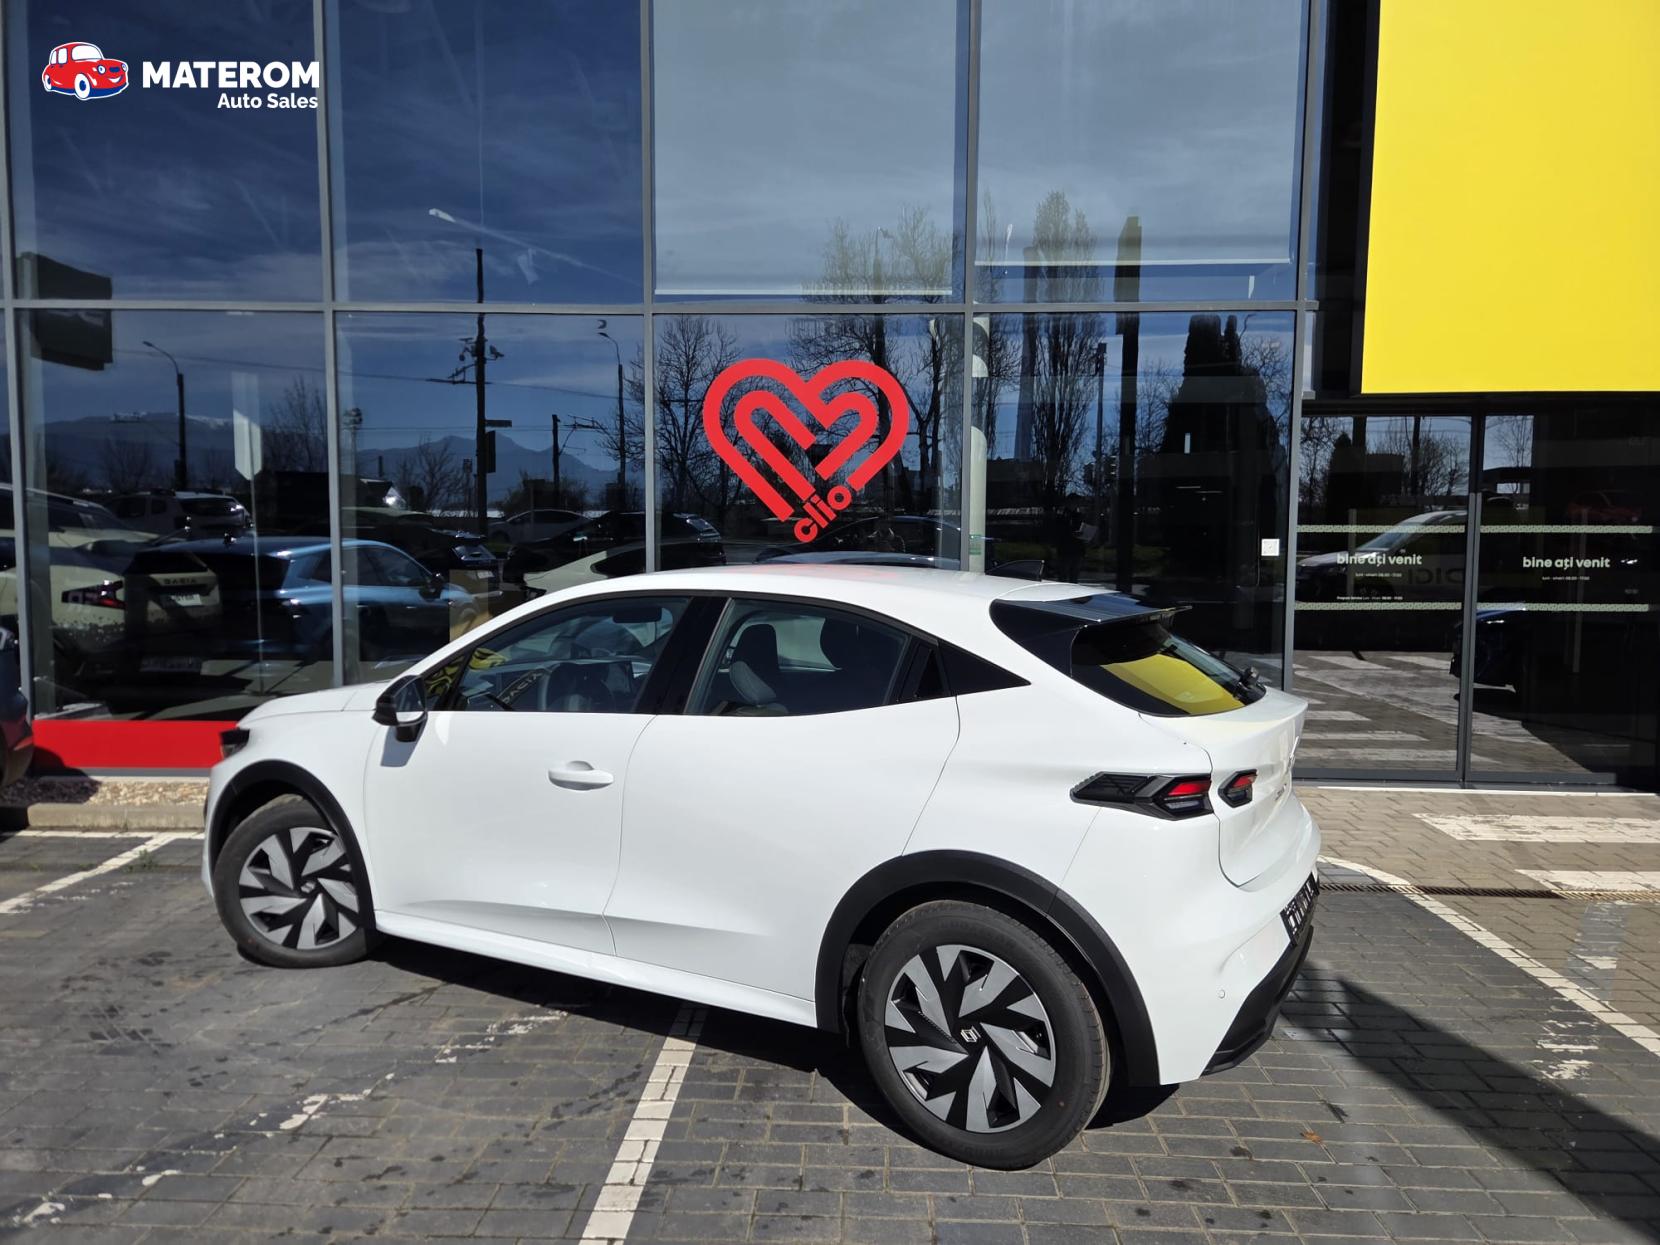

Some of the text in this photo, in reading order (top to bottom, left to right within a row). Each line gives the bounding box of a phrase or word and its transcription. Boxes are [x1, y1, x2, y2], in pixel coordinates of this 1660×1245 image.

[794, 485, 852, 543] clio
[1336, 554, 1366, 565] bine
[1388, 554, 1422, 565] venit
[1522, 556, 1552, 568] bine
[1575, 556, 1611, 568] venit
